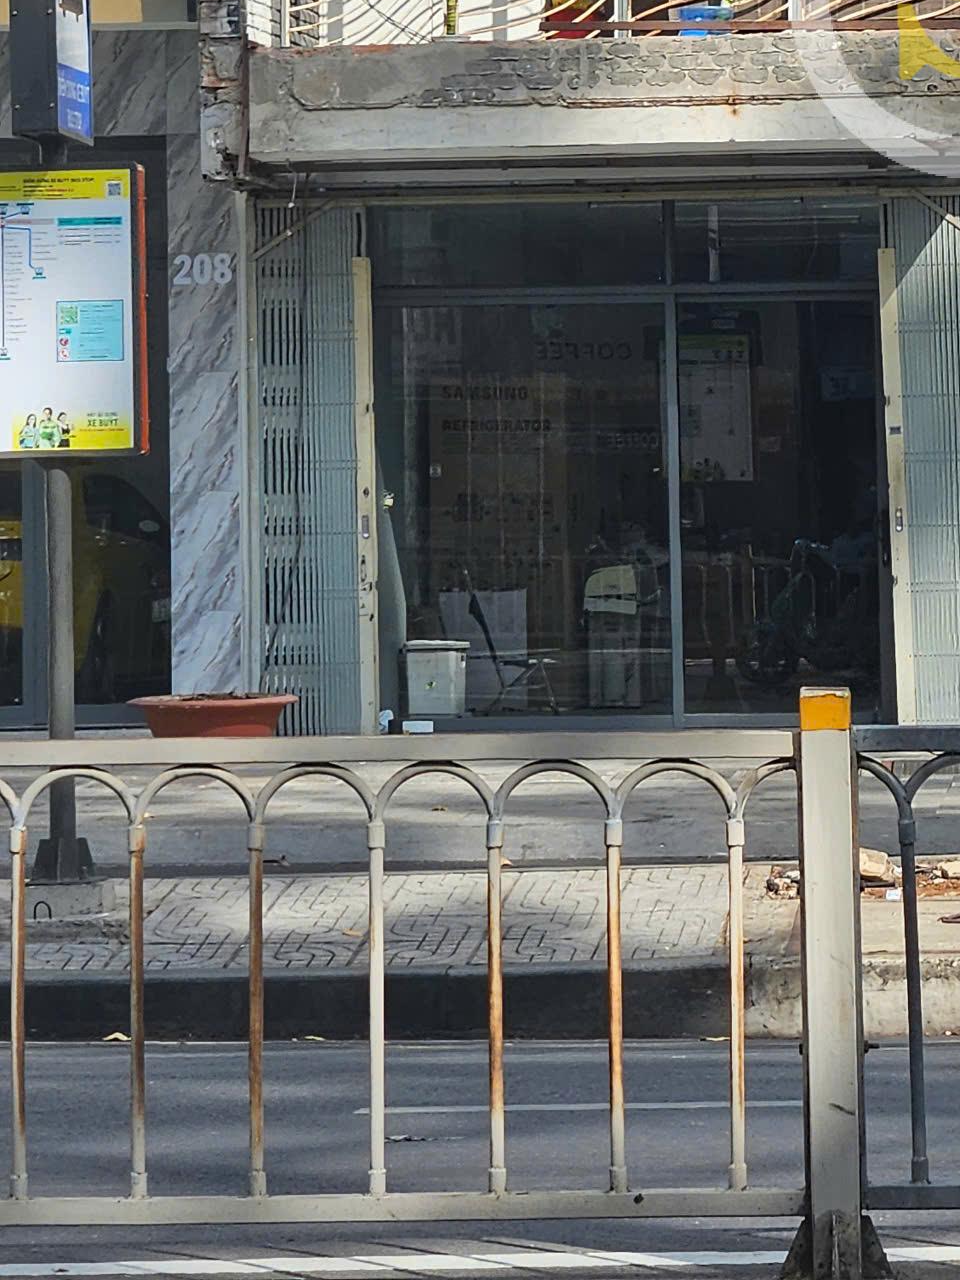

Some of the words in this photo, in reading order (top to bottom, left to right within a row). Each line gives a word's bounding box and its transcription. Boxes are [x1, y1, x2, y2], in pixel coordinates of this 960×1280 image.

[173, 253, 232, 286] 208
[440, 385, 529, 401] SAMSUNG
[441, 418, 552, 433] REFRIGERATOR
